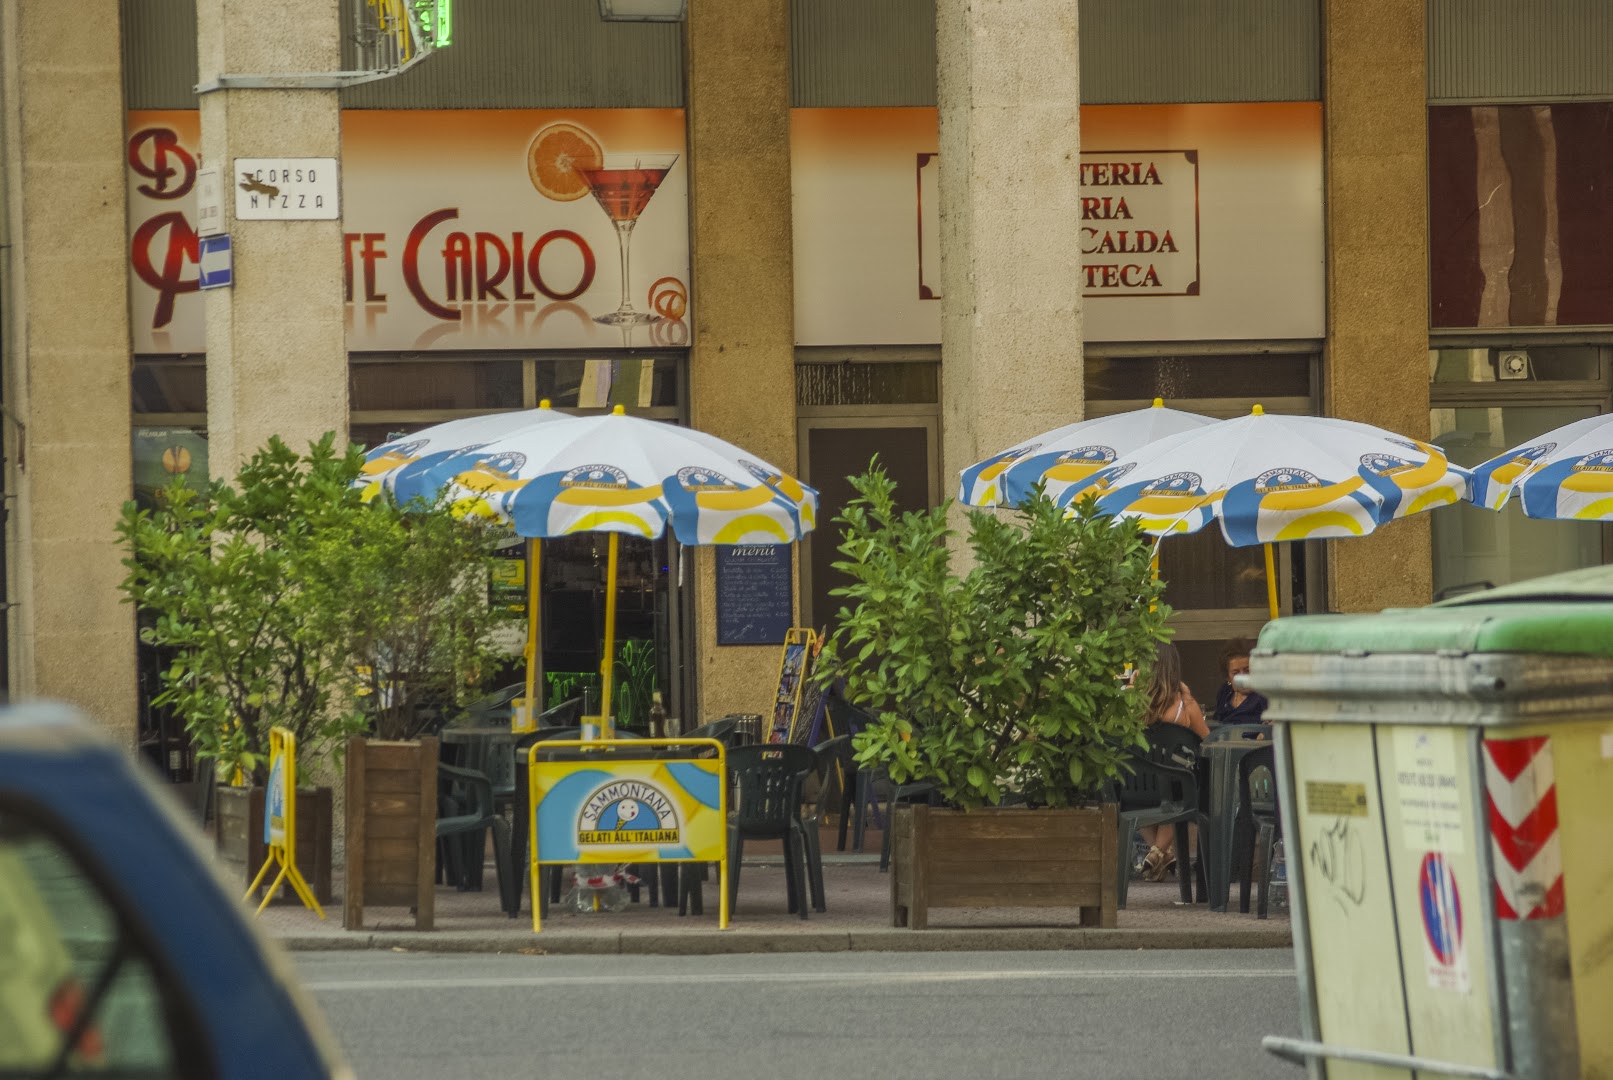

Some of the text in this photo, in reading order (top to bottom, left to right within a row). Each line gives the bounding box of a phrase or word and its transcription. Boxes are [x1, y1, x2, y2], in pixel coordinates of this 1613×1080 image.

[256, 169, 317, 183] CORSO
[251, 194, 323, 209] NIZZA
[1081, 227, 1179, 254] CALDA
[402, 207, 596, 321] CARLO
[583, 782, 671, 821] SAMMONTANA
[579, 832, 611, 843] GELATI
